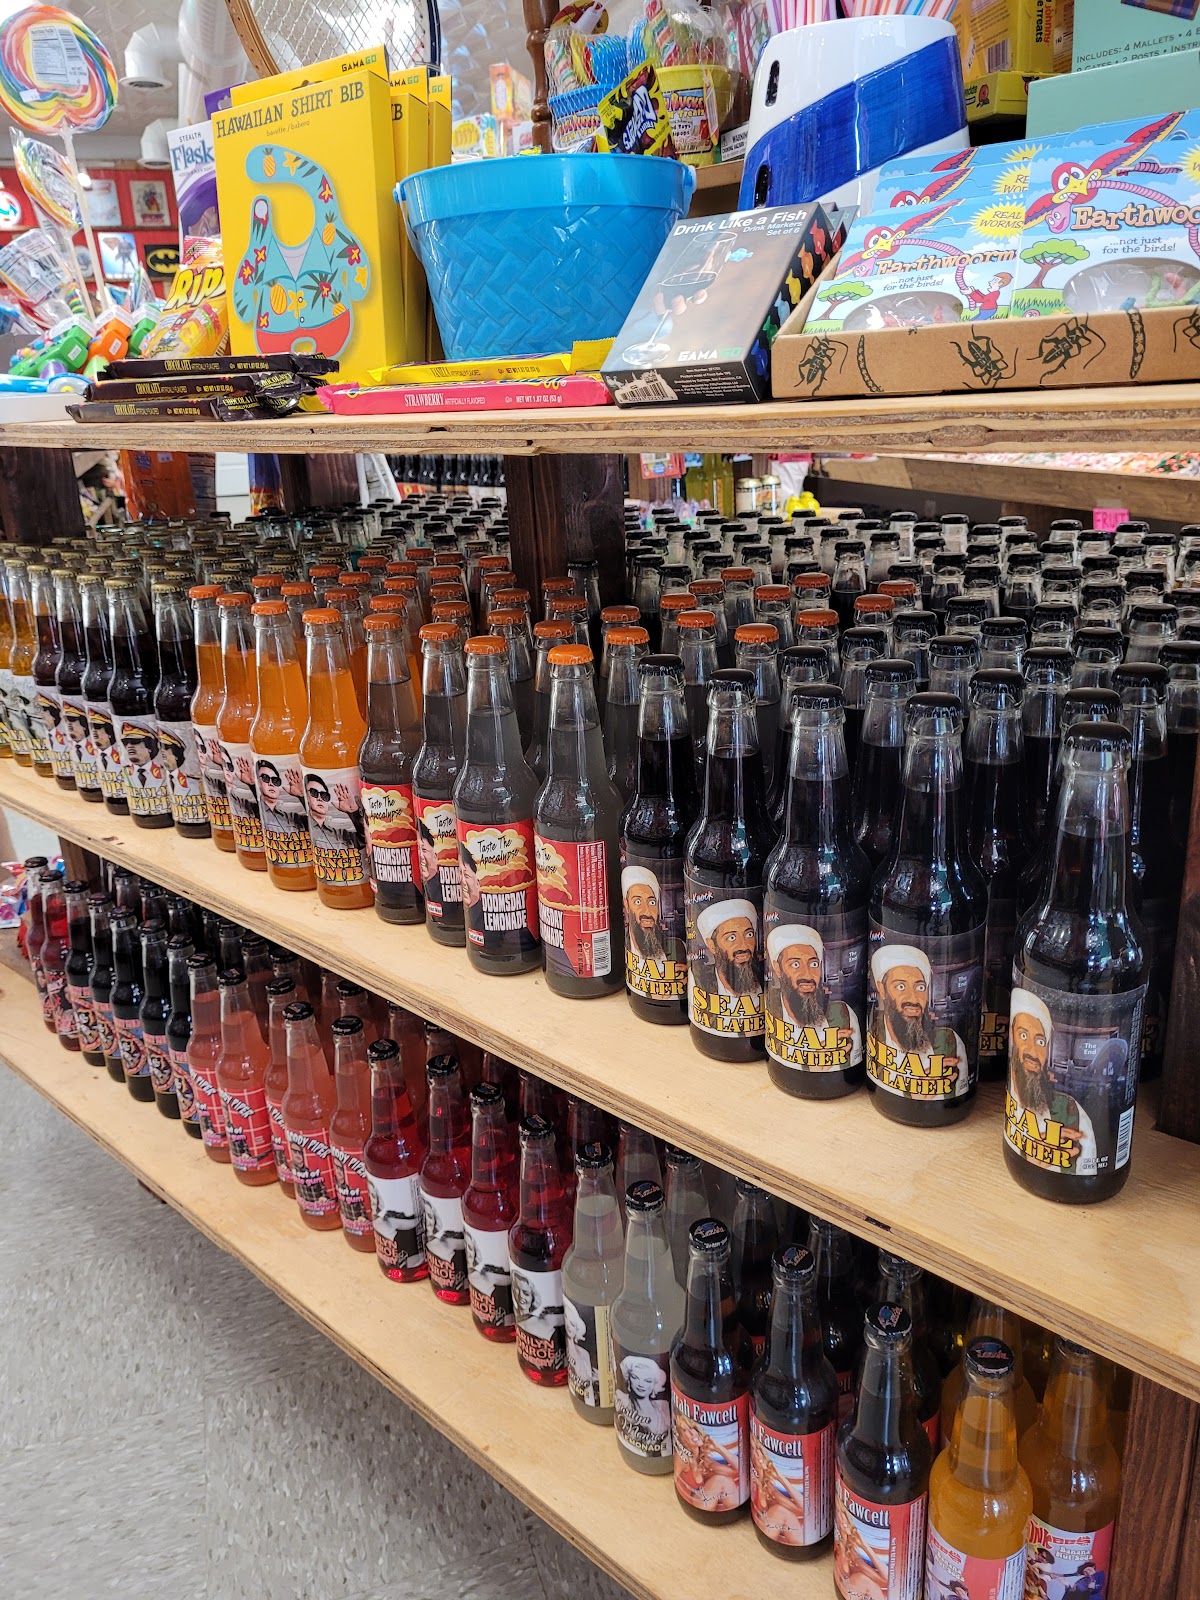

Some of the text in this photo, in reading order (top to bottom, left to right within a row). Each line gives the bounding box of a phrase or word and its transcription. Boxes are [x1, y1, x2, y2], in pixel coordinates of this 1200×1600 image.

[1077, 47, 1121, 63] INCLUDES:
[1133, 34, 1175, 49] MALLETS
[389, 75, 420, 88] AMAGO
[216, 81, 365, 138] HAWAIIAN SHIRT BIB
[672, 93, 704, 111] BUCKE
[179, 132, 202, 143] STEALTH
[732, 131, 748, 143] WARNIN
[171, 139, 214, 172] Flask
[673, 210, 807, 237] Drink Like a Fish
[992, 211, 1022, 220] REAL
[743, 221, 802, 233] Drink Markers
[1102, 243, 1176, 254] for the birds!
[1140, 236, 1162, 246] just
[883, 284, 896, 292] for
[916, 279, 944, 288] birds!
[915, 275, 934, 283] just
[404, 392, 444, 406] STRAWBERRY
[516, 396, 524, 404] NET
[524, 396, 532, 404] WT
[1094, 512, 1128, 528] FRUIT
[368, 795, 396, 809] Taste The
[435, 814, 454, 828] Taste
[437, 828, 456, 844] Apoca
[478, 836, 512, 854] Taste The
[266, 850, 313, 864] OMB
[314, 846, 360, 858] CLEAR
[373, 846, 411, 866] DOOMSDAY
[480, 849, 520, 869] Apocalypse
[315, 865, 364, 881] OMB
[375, 865, 412, 883] LEMONADE
[439, 866, 460, 884] DOOM
[442, 884, 463, 902] LEMO
[482, 890, 526, 912] DOOMSDAY
[484, 910, 528, 932] LEMONADE
[626, 950, 686, 982] EAL
[631, 974, 686, 996] LATER
[693, 1008, 764, 1033] YA LATE
[765, 1010, 848, 1050] SEAL
[780, 1044, 848, 1067] LATER
[867, 1031, 953, 1078] SEAL
[196, 1075, 217, 1096] PIPER
[883, 1070, 952, 1096] LATER
[231, 1098, 255, 1118] PIPER
[1006, 1090, 1074, 1150] EAL
[308, 1140, 332, 1159] PIPER
[1006, 1125, 1072, 1168] LATER
[306, 1176, 324, 1187] gum
[310, 1168, 320, 1178] of
[350, 1188, 360, 1196] of
[516, 1328, 554, 1350] ARILYN
[516, 1337, 555, 1358] ONROE
[693, 1403, 738, 1424] Fawcett
[620, 1432, 667, 1451] LEMONADE
[758, 1427, 802, 1457] Fawcett
[844, 1488, 890, 1527] Fawcett
[1055, 1552, 1093, 1561] Nut Soda
[1060, 1546, 1090, 1556] Banana
